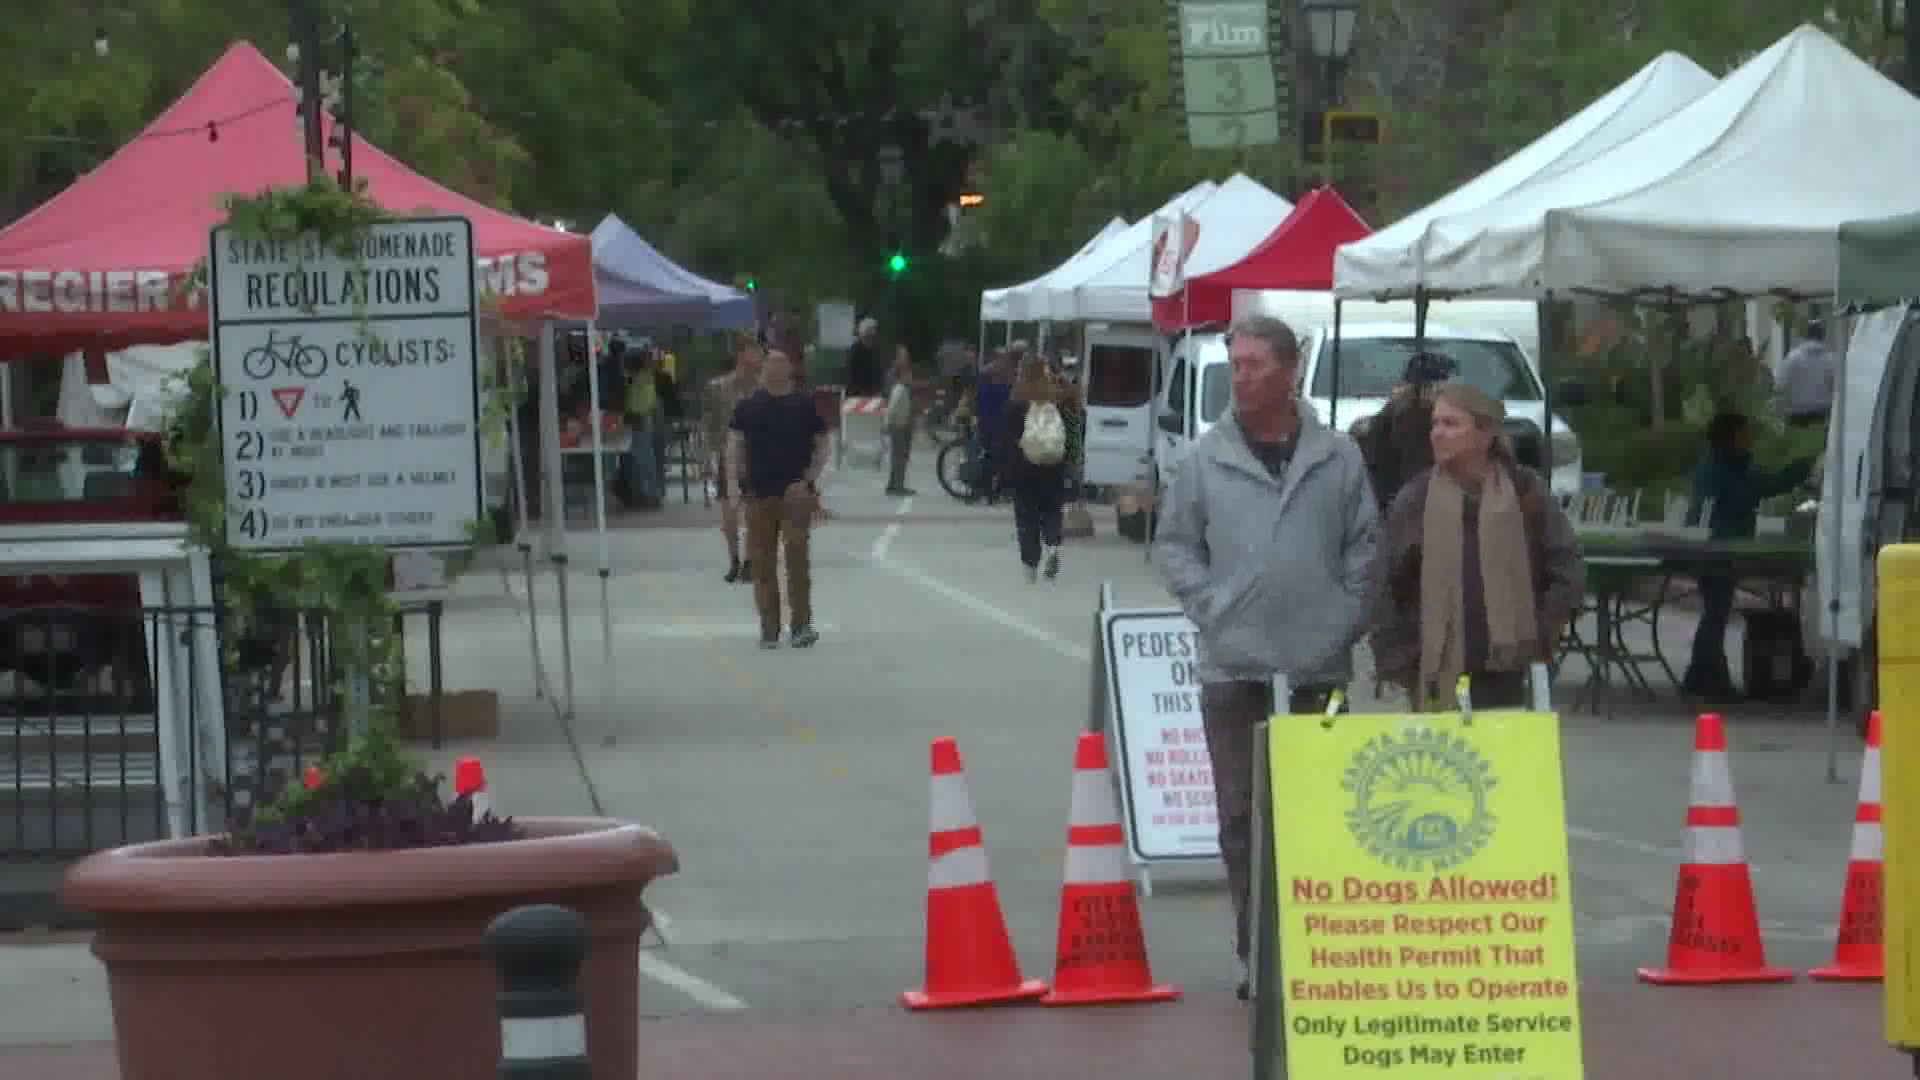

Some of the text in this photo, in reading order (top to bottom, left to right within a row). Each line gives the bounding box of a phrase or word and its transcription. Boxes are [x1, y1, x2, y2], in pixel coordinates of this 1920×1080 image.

[1188, 16, 1263, 46] Film
[228, 238, 290, 264] STATE
[247, 266, 441, 310] REGULATIONS
[235, 430, 264, 460] 2)
[237, 470, 265, 500] 3)
[239, 508, 268, 539] 4)
[1152, 692, 1192, 713] THIS
[1292, 873, 1557, 903] No Dogs Allowed!
[1304, 911, 1547, 938] Please Respect Our
[1311, 943, 1545, 969] Health Permit That
[1290, 975, 1569, 1004] Enables Us to Operate
[1292, 1011, 1572, 1038] Only Legitimate Service
[1342, 1043, 1527, 1068] Dogs May Enter
